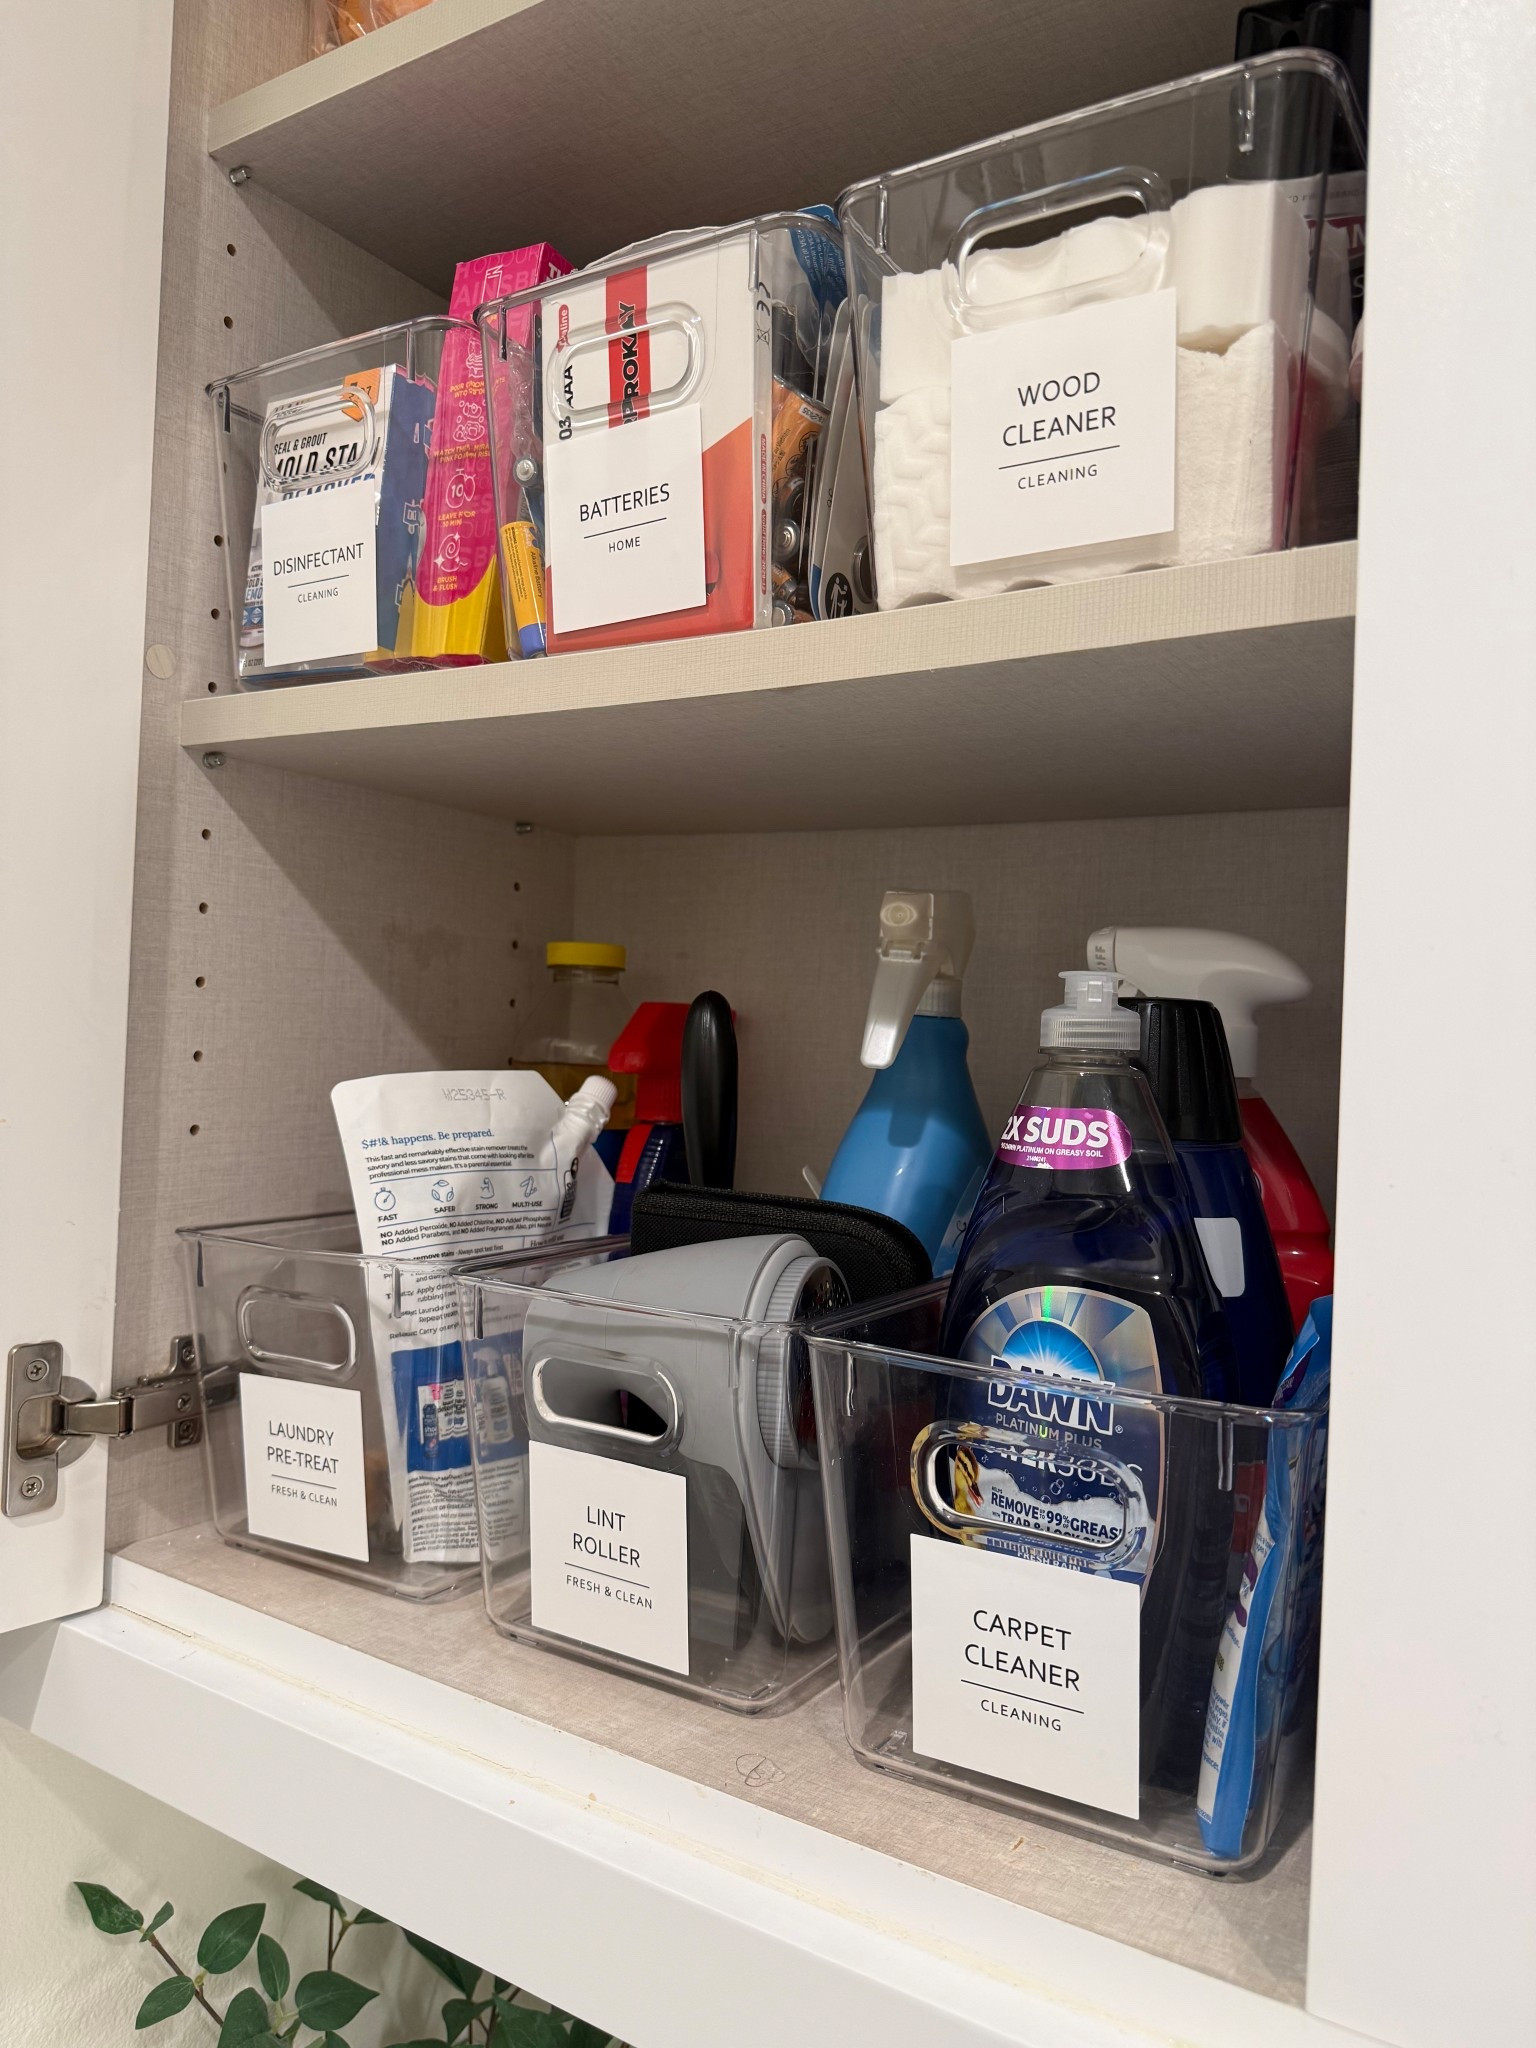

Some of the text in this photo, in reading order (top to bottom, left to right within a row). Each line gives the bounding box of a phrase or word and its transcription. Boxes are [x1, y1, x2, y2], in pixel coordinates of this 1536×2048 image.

[1017, 371, 1101, 407] WOOD
[1002, 405, 1116, 447] CLEANER
[274, 432, 328, 455] SEAL & GROUT
[1017, 463, 1098, 490] CLEANING
[451, 484, 464, 498] 10
[580, 483, 670, 522] BATTERIES
[608, 536, 641, 553] HOME
[273, 542, 365, 576] DISINFECTANT
[437, 576, 458, 584] BRUSH
[297, 587, 339, 604] CLEANING
[391, 1134, 436, 1146] happens.
[438, 1131, 450, 1140] Be
[452, 1128, 495, 1141] prepared.
[1001, 1115, 1109, 1148] 2X SUDS
[408, 1148, 444, 1158] remarkably
[1017, 1144, 1044, 1154] PLATINUM
[1055, 1149, 1085, 1157] GREASY
[1085, 1149, 1104, 1157] SOIL
[367, 1163, 390, 1172] savory
[391, 1160, 404, 1168] and
[417, 1157, 438, 1166] savory
[369, 1168, 410, 1180] professional
[378, 1213, 398, 1222] FAST
[434, 1205, 456, 1214] SAFER
[394, 1227, 418, 1236] Added
[420, 1222, 449, 1232] Peroxide,
[395, 1234, 420, 1244] Added
[421, 1230, 451, 1239] Parabens,
[417, 1286, 435, 1294] Apply
[419, 1327, 437, 1335] Carry
[987, 1355, 1116, 1436] DAWN
[269, 1420, 334, 1447] LAUNDRY
[995, 1412, 1103, 1450] PLATINUM PLUS
[267, 1446, 339, 1474] PRE-TREAT
[271, 1484, 338, 1507] FRESH & CLEAN
[991, 1491, 1039, 1520] REMOVE
[587, 1505, 626, 1532] LINT
[573, 1532, 640, 1568] ROLLER
[566, 1574, 653, 1610] FRESH & CLEAN
[973, 1609, 1072, 1650] CARPET
[964, 1643, 1081, 1692] CLEANER
[980, 1699, 1062, 1732] CLEANING
